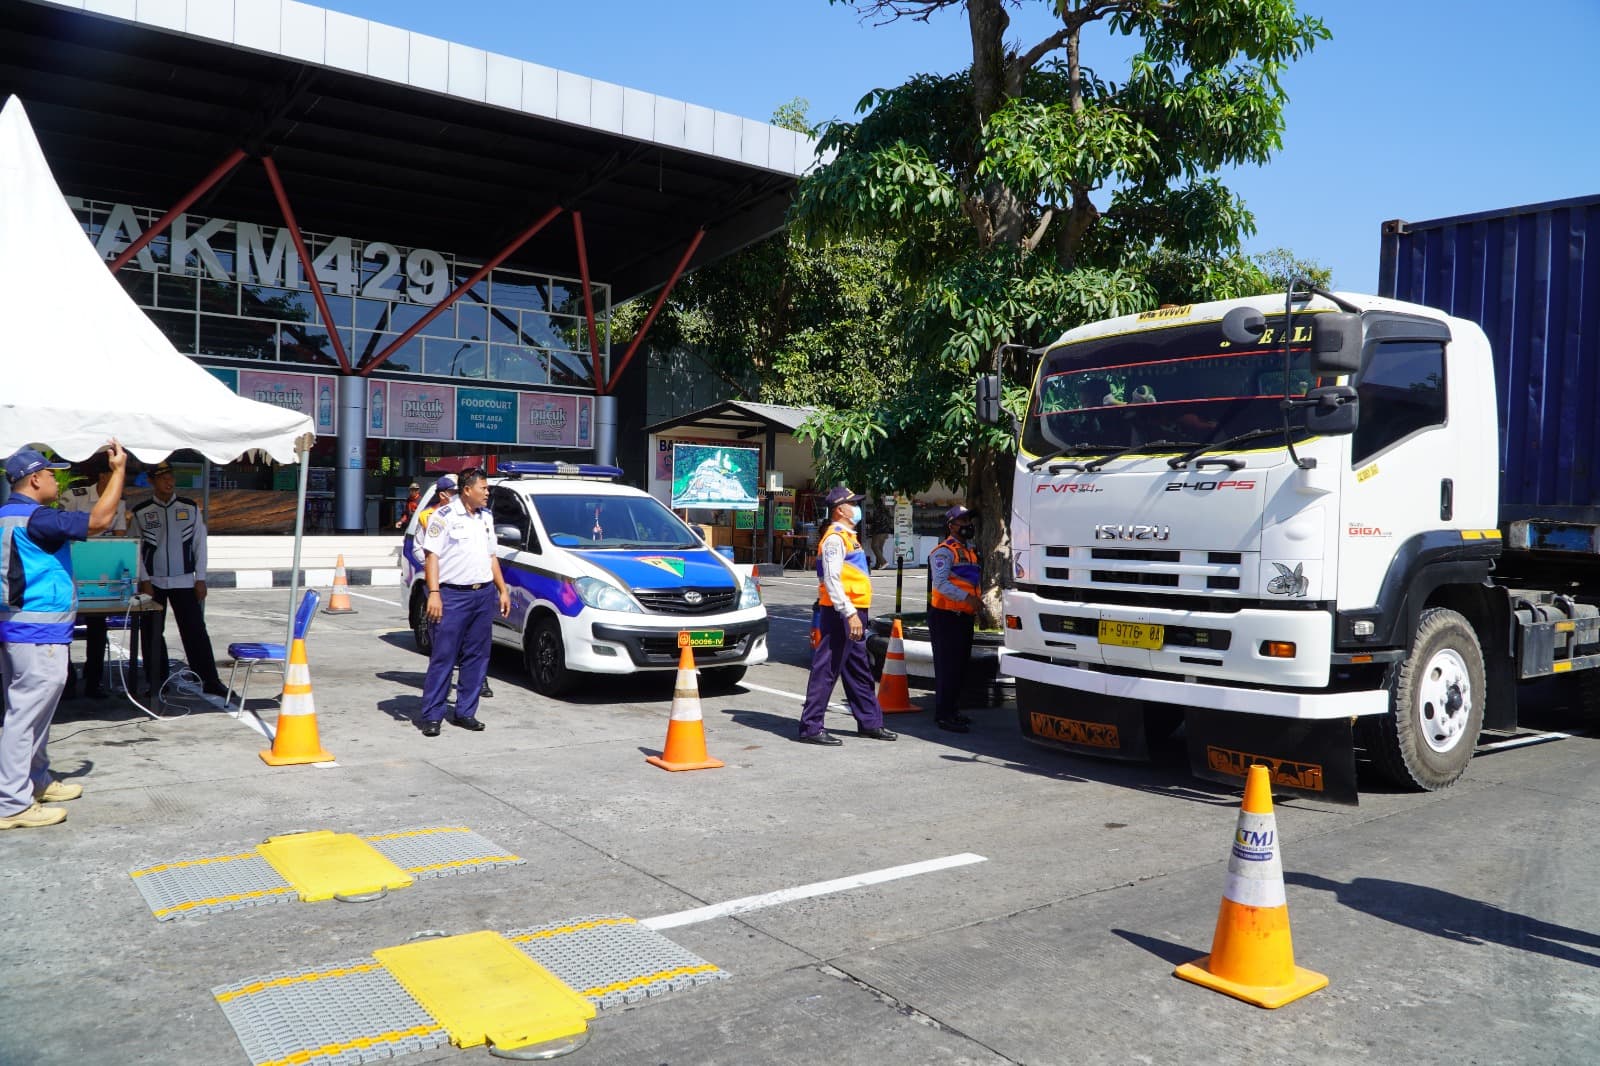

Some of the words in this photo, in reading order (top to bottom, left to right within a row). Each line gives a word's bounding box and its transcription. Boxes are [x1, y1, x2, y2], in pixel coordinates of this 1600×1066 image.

[402, 399, 443, 417] pucuk
[461, 398, 512, 409] FOODCOURT
[486, 415, 503, 423] AREA
[1036, 483, 1079, 493] FVR
[1165, 480, 1257, 492] 240PS
[1095, 524, 1170, 541] ISUZU
[1348, 527, 1382, 536] GIGA
[1116, 624, 1140, 639] 9776
[1241, 829, 1274, 847] TMJ
